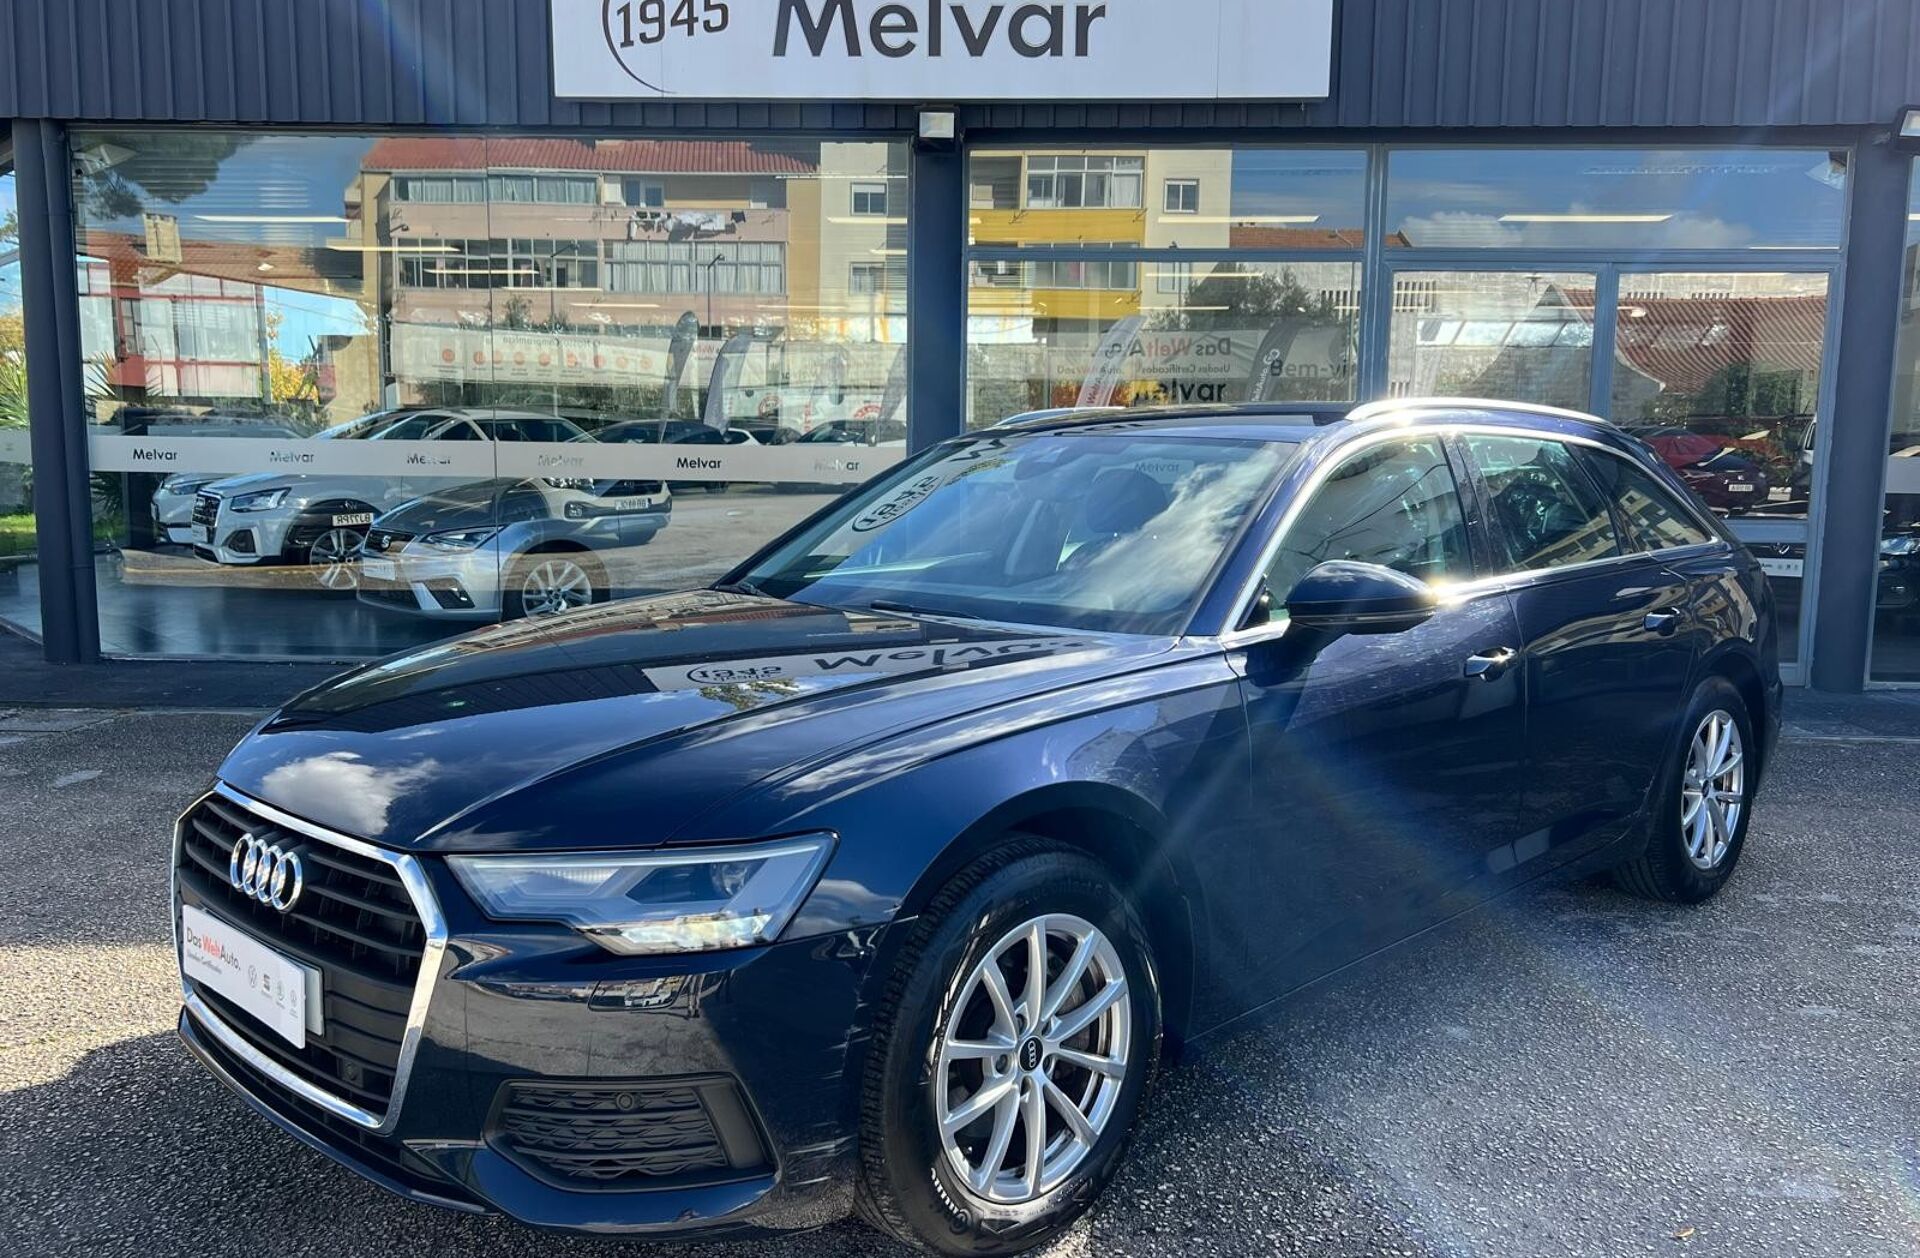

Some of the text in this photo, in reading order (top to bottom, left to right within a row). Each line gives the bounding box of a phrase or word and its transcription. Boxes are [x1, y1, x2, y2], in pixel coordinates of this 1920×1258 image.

[616, 0, 730, 48] 1945
[772, 0, 1106, 58] Melvar
[132, 448, 178, 460] Melvar
[406, 453, 451, 465] Mear
[676, 457, 722, 469] Melvar
[814, 458, 860, 471] Mlvar
